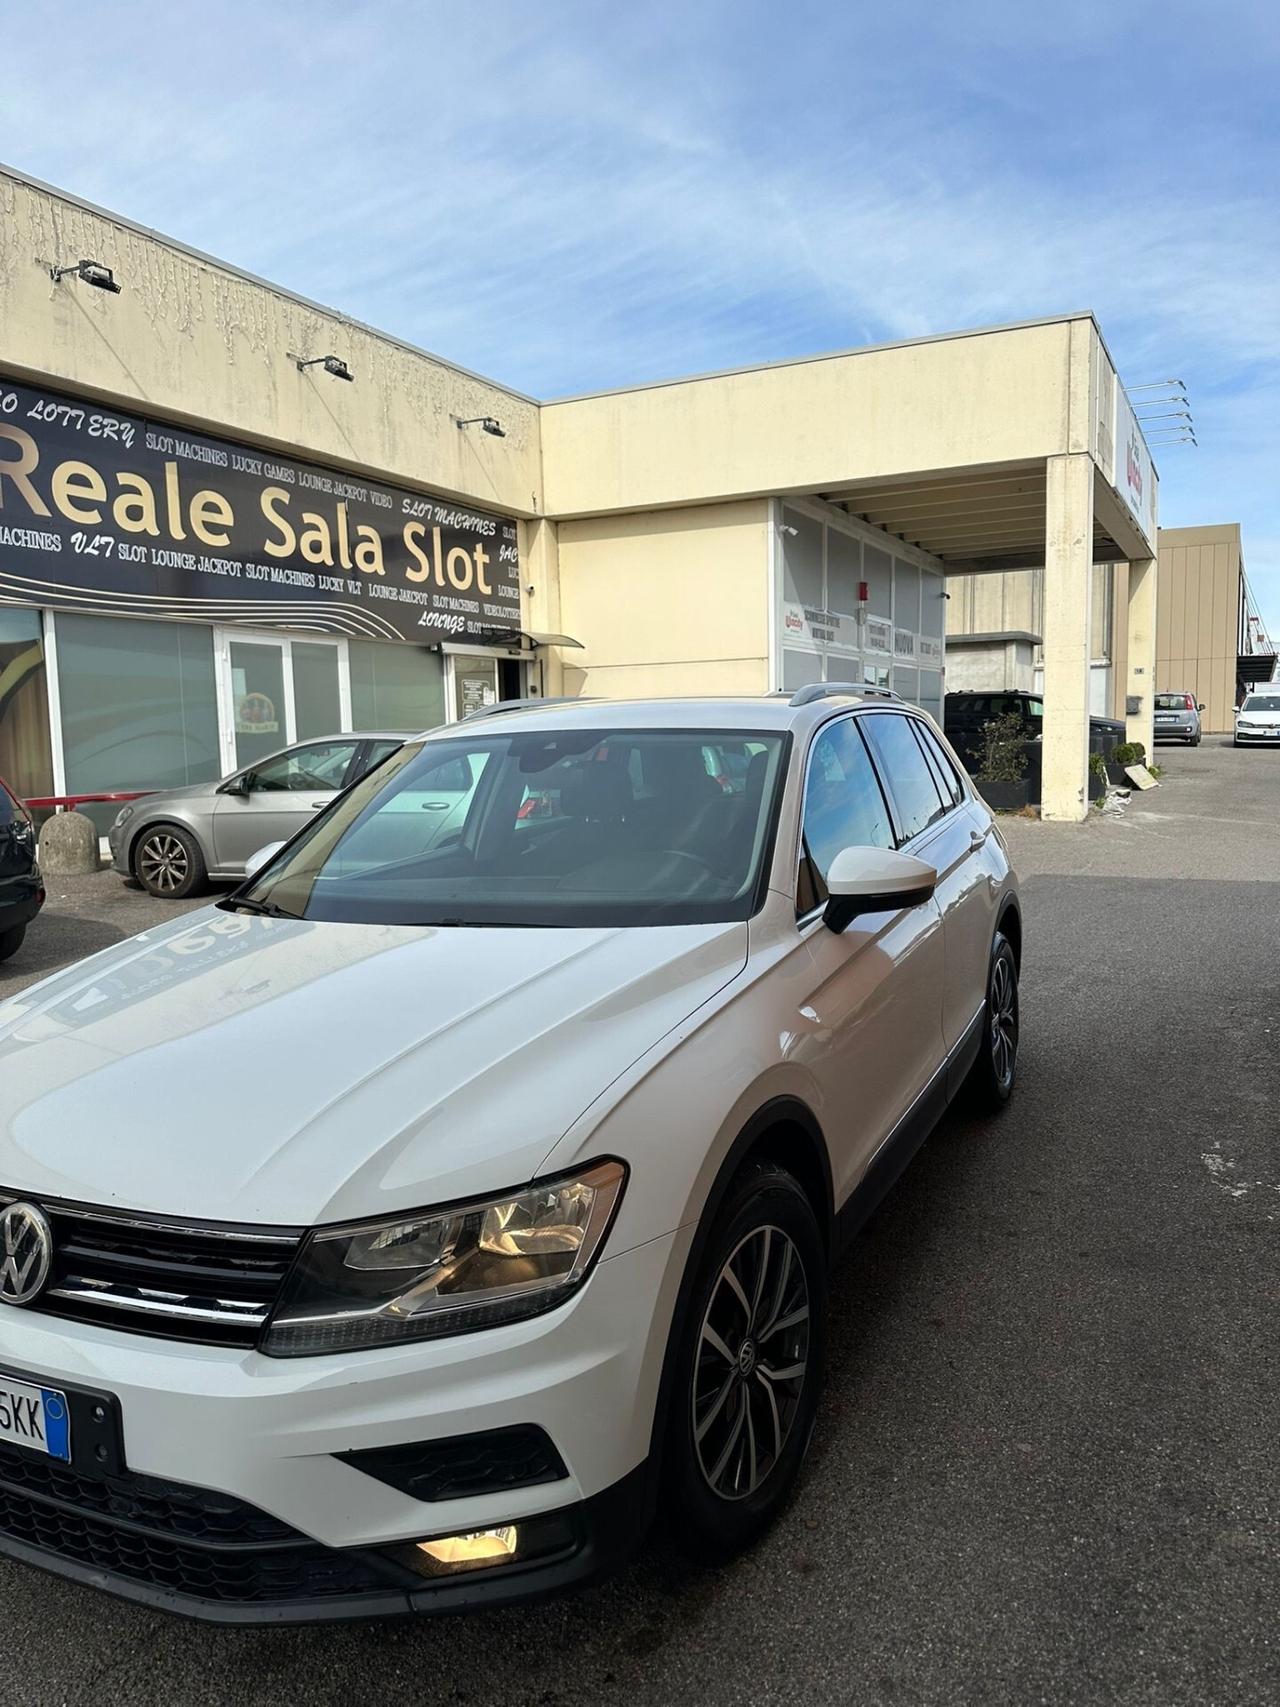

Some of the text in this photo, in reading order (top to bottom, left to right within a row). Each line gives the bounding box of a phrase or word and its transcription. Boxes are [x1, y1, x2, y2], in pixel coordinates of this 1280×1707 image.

[27, 400, 136, 449] LOTTERY
[146, 433, 393, 509] SLOT MACHINES LUCKY GAMES LOUNGE JACKPOT VIDEO
[0, 422, 492, 595] Reale Sala Slot
[402, 498, 496, 536] SLOT MACHINES
[70, 531, 115, 558] VLT
[118, 543, 147, 563] SLOT
[151, 548, 197, 571] LOUNGE
[198, 556, 242, 577] JACKPOT
[246, 563, 269, 581] SLOT
[271, 567, 315, 588] MACHINES
[319, 575, 344, 592] LUCKY
[347, 580, 362, 595] VLT
[368, 583, 398, 600] LOUNGE
[433, 595, 449, 609] SLOT
[449, 597, 480, 613] MACHINES
[418, 611, 482, 634] LOUNGE SLOT
